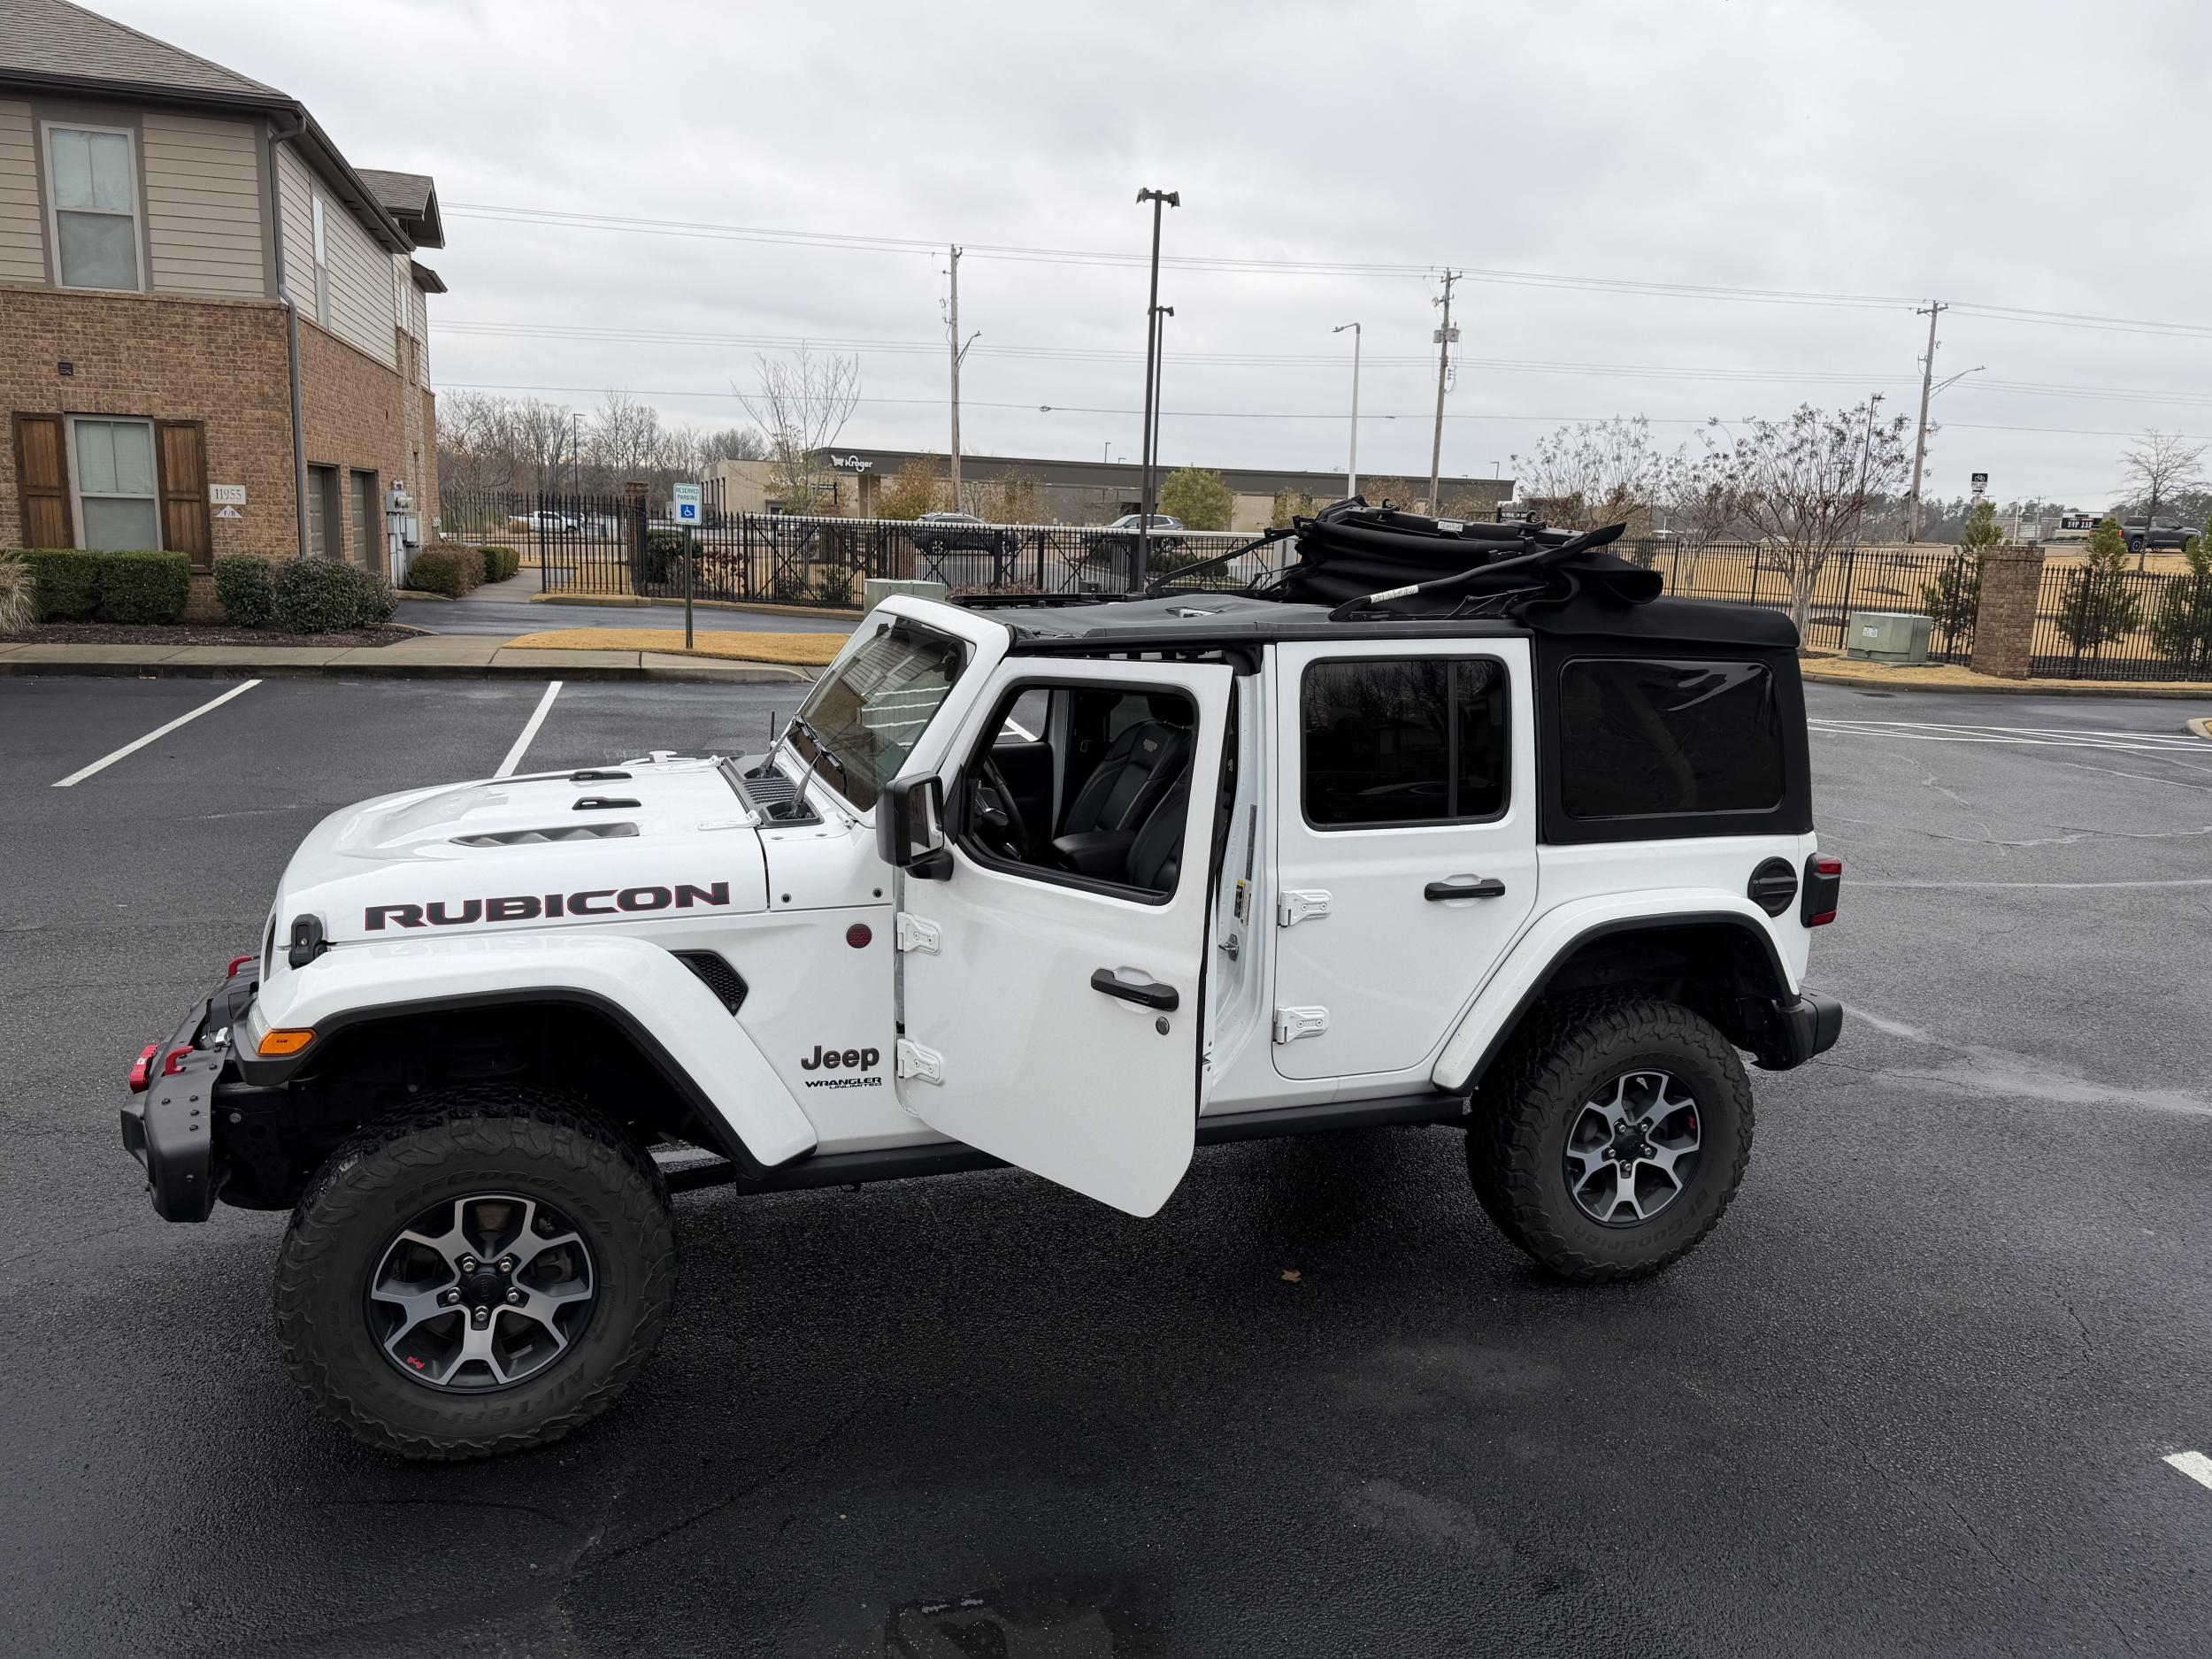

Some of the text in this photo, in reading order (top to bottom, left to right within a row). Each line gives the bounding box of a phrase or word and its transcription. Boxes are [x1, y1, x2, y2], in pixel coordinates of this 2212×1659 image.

[845, 455, 873, 472] Kroger
[215, 488, 242, 500] 11955
[365, 881, 731, 932] RUBICON
[801, 1045, 880, 1071] Jeep
[805, 1077, 882, 1088] WRANGLER
